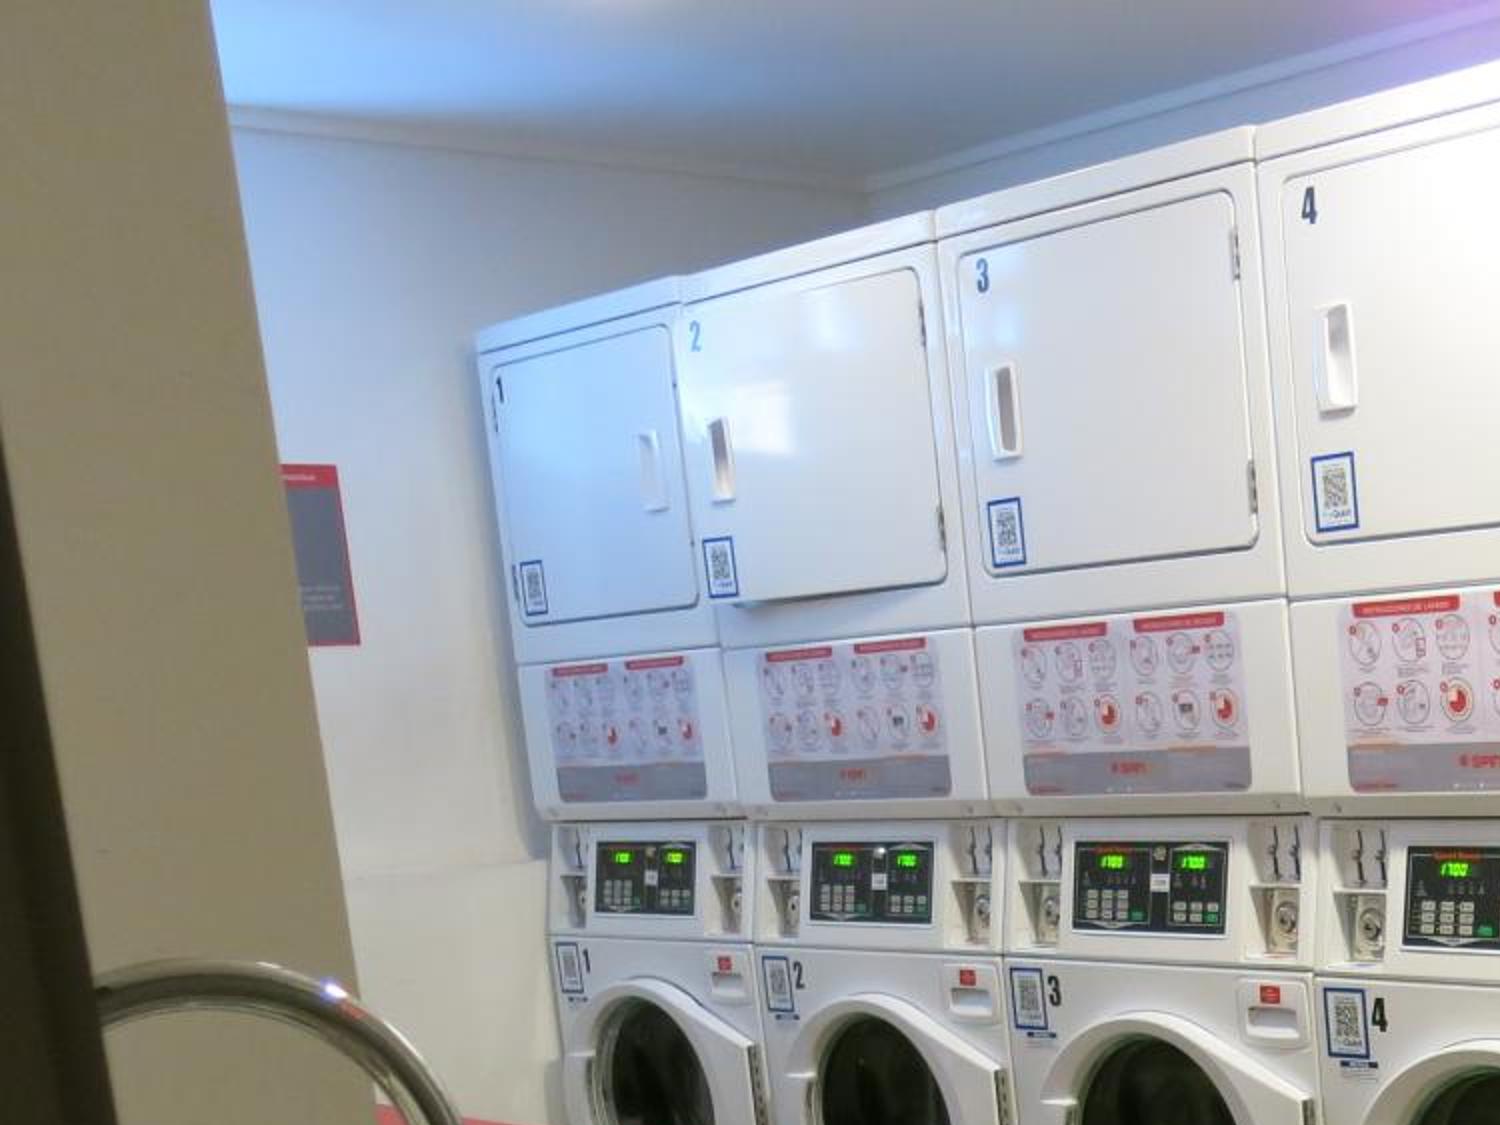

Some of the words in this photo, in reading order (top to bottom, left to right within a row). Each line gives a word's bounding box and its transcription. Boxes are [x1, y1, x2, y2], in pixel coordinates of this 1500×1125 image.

[1300, 186, 1318, 225] 4
[976, 258, 990, 293] 3
[689, 320, 702, 353] 2
[496, 377, 505, 404] 1
[583, 949, 591, 973] 1
[793, 961, 805, 989] 2
[1047, 975, 1062, 1007] 3
[1371, 997, 1388, 1032] 4
